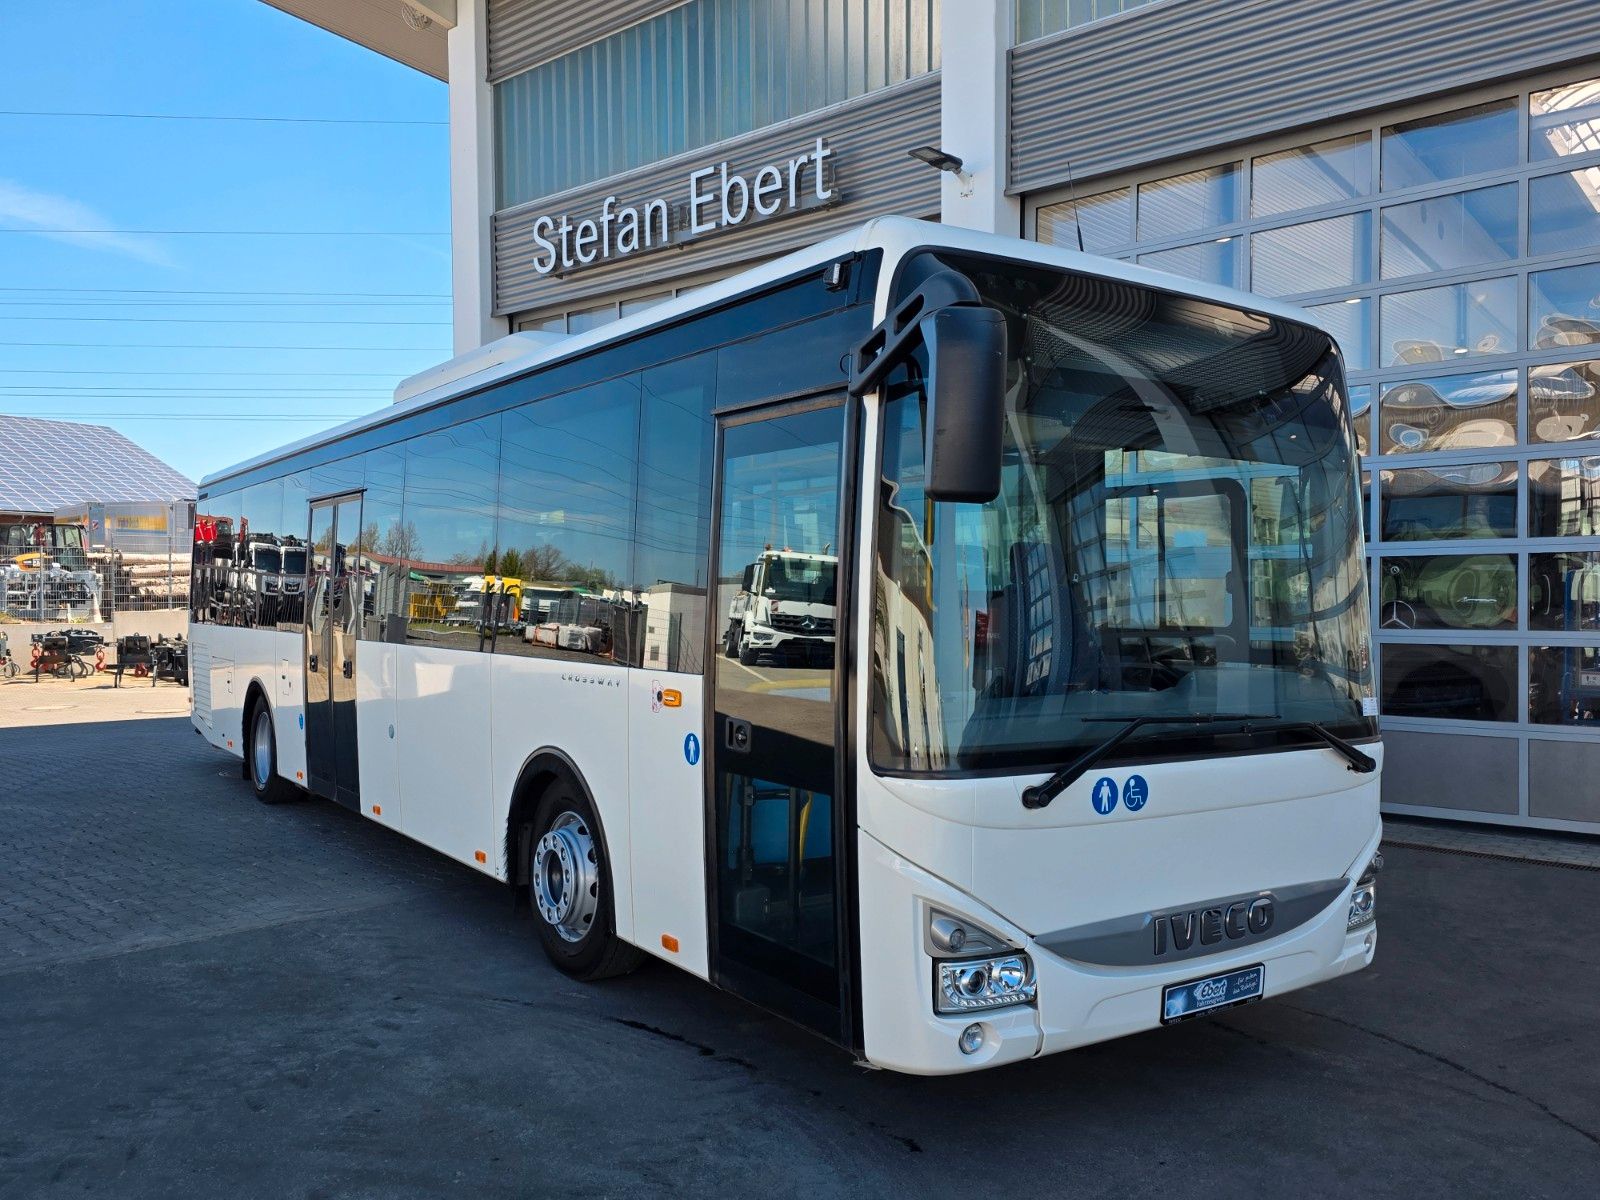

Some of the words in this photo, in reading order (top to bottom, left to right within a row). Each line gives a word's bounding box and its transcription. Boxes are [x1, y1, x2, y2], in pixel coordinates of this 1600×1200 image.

[532, 195, 669, 275] Stefan
[690, 137, 833, 235] Ebert
[1154, 897, 1274, 956] IVECO
[1200, 980, 1226, 999] Ebert
